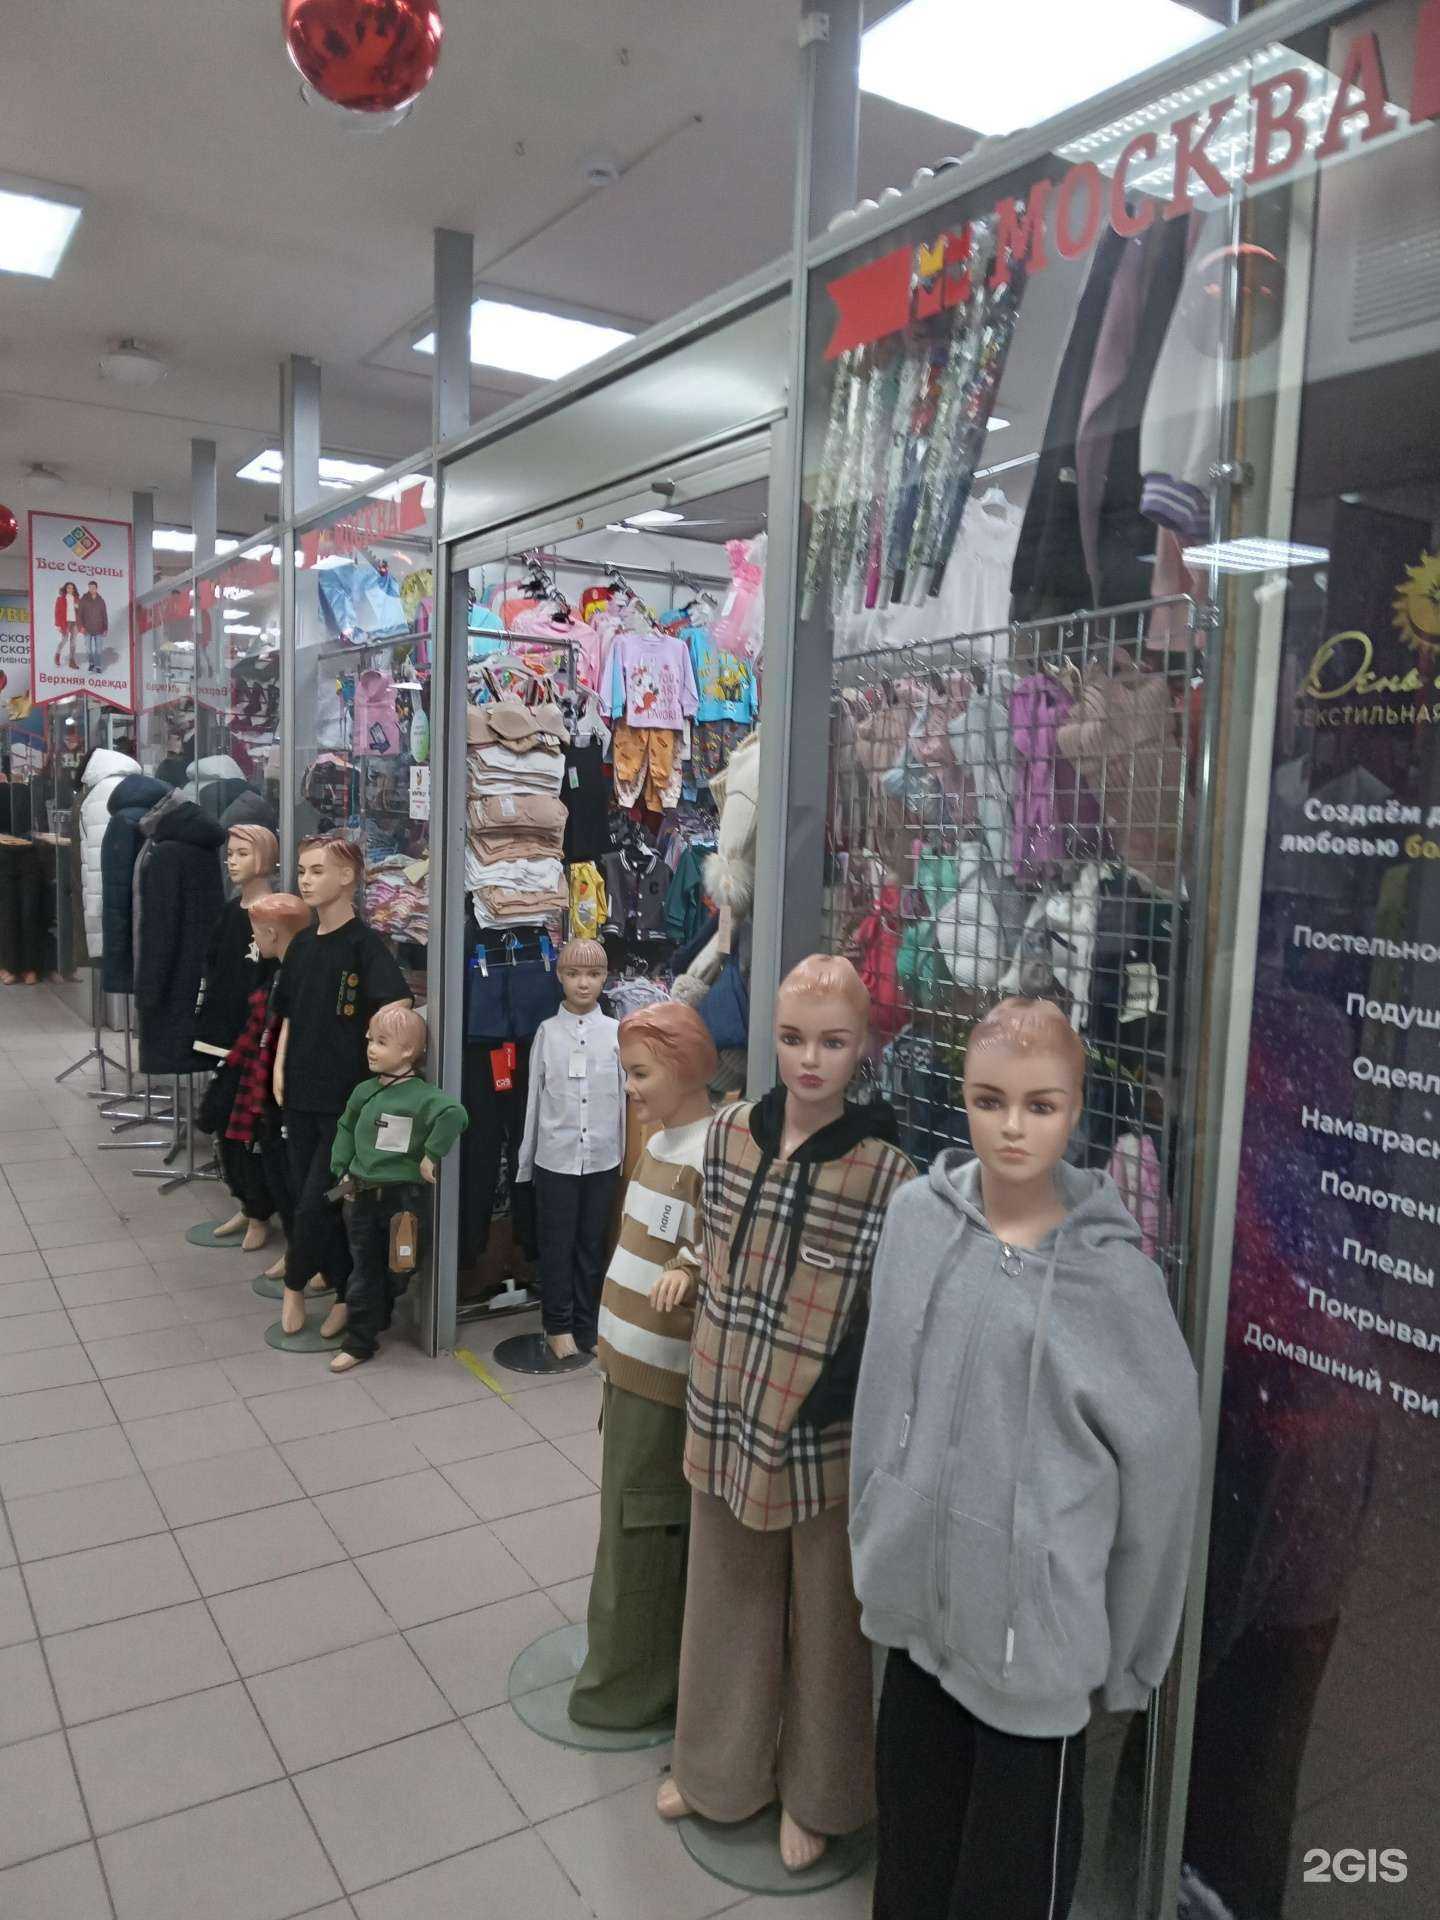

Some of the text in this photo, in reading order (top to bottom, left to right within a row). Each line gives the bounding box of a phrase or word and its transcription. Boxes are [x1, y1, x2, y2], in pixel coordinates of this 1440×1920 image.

[990, 31, 1400, 288] МОСКВА
[36, 558, 124, 577] Все Сезоны
[39, 672, 127, 689] Верхняя одежда
[1303, 798, 1422, 827] Создаём
[1280, 830, 1400, 858] любовью
[1342, 1237, 1435, 1288] Пледы
[1244, 1322, 1382, 1395] Домашний
